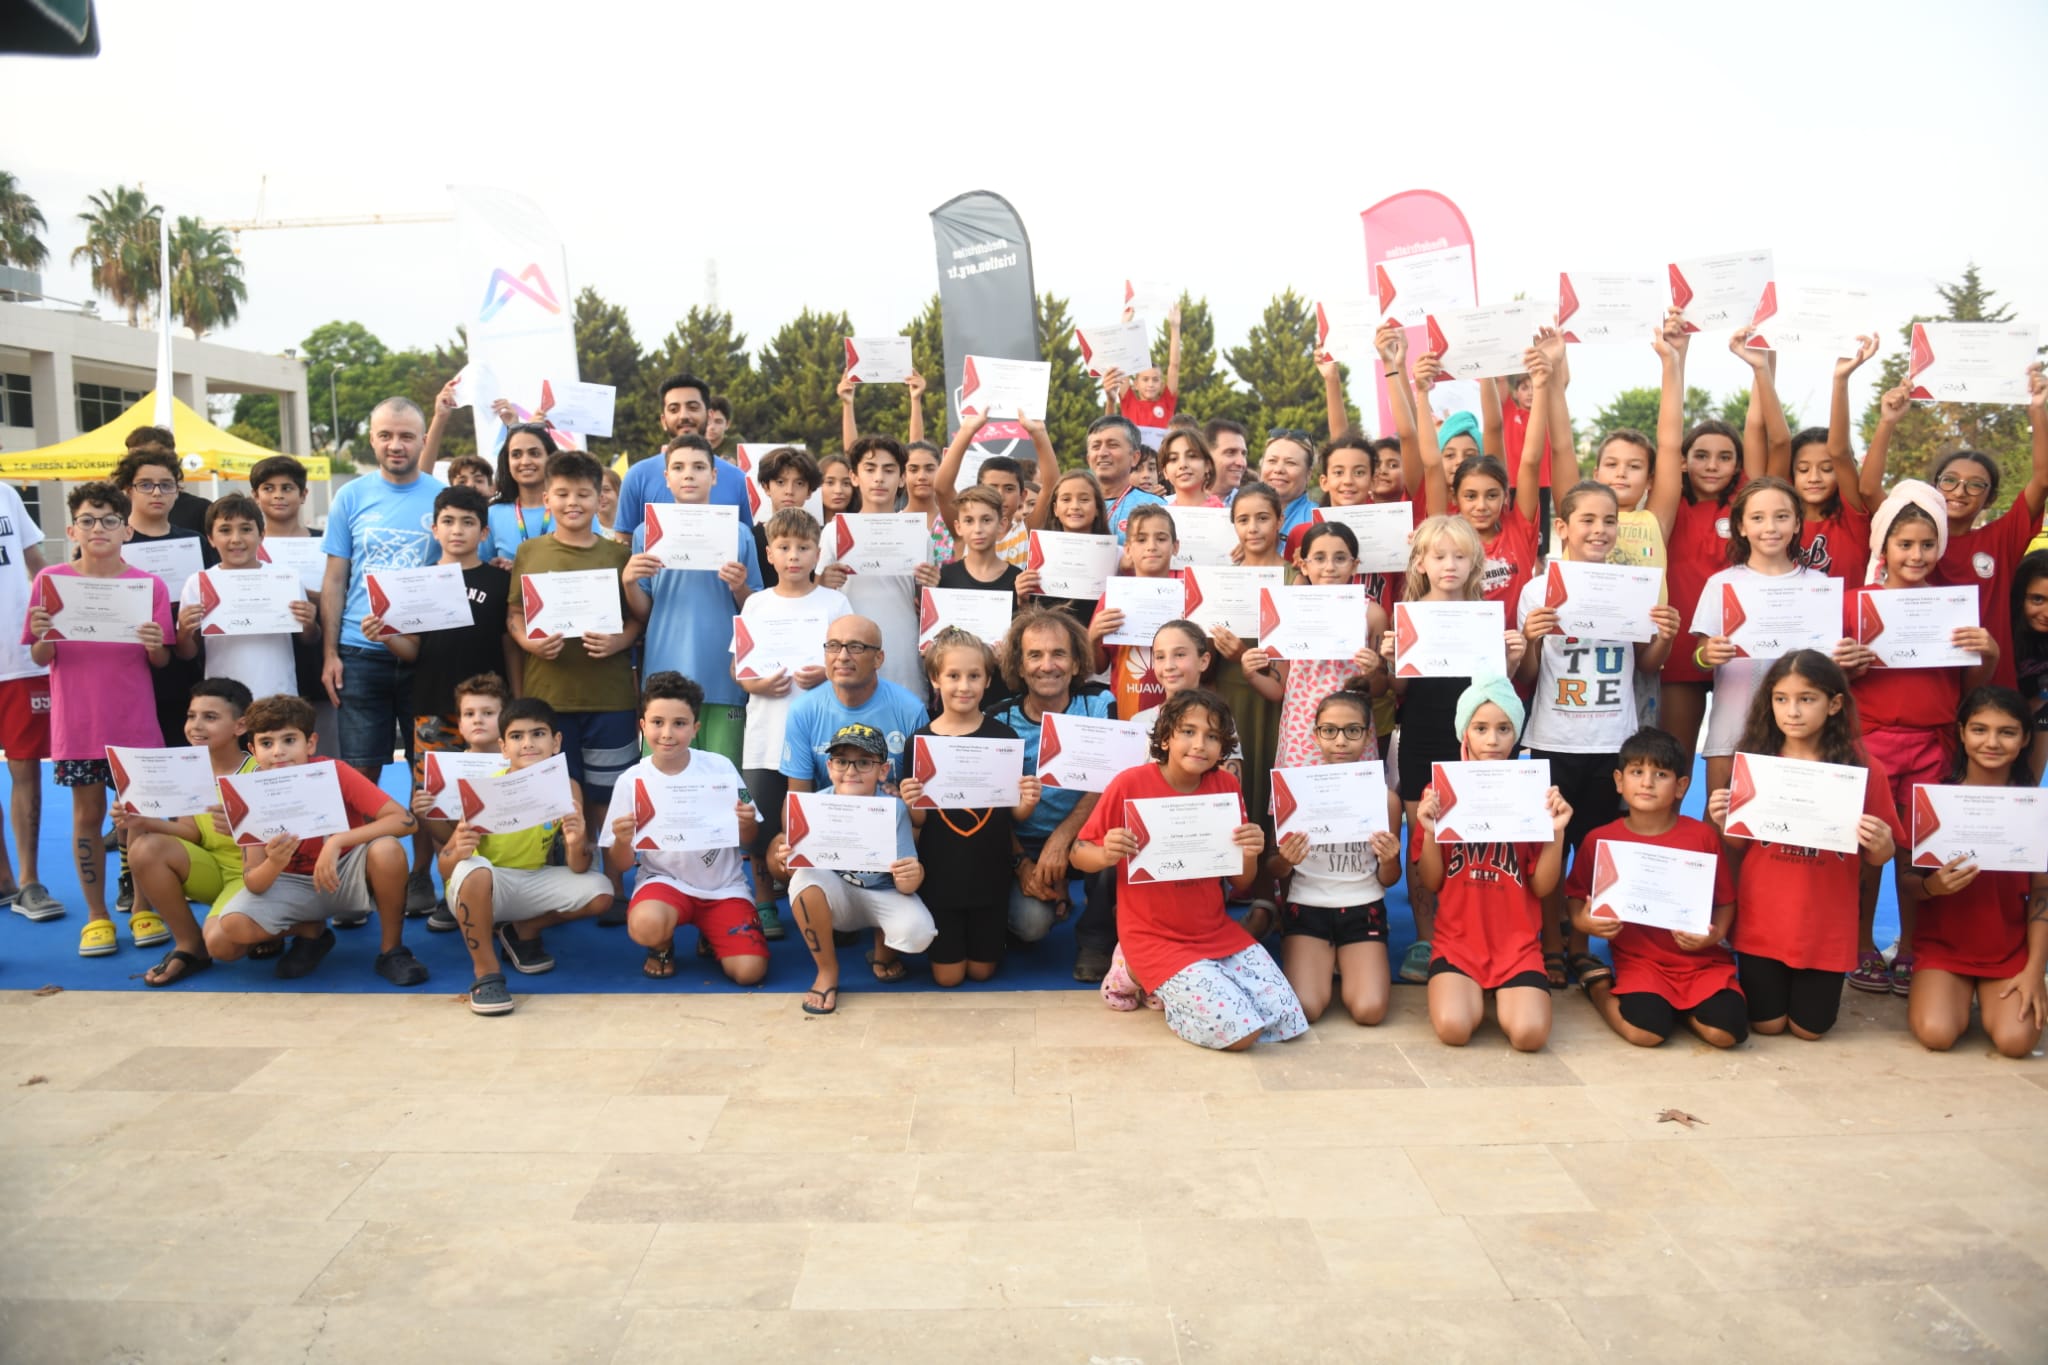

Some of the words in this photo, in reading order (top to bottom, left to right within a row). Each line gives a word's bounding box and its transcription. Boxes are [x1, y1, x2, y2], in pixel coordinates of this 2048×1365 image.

[465, 587, 487, 604] ND
[1126, 683, 1165, 693] HUAW
[1328, 853, 1362, 872] STARS
